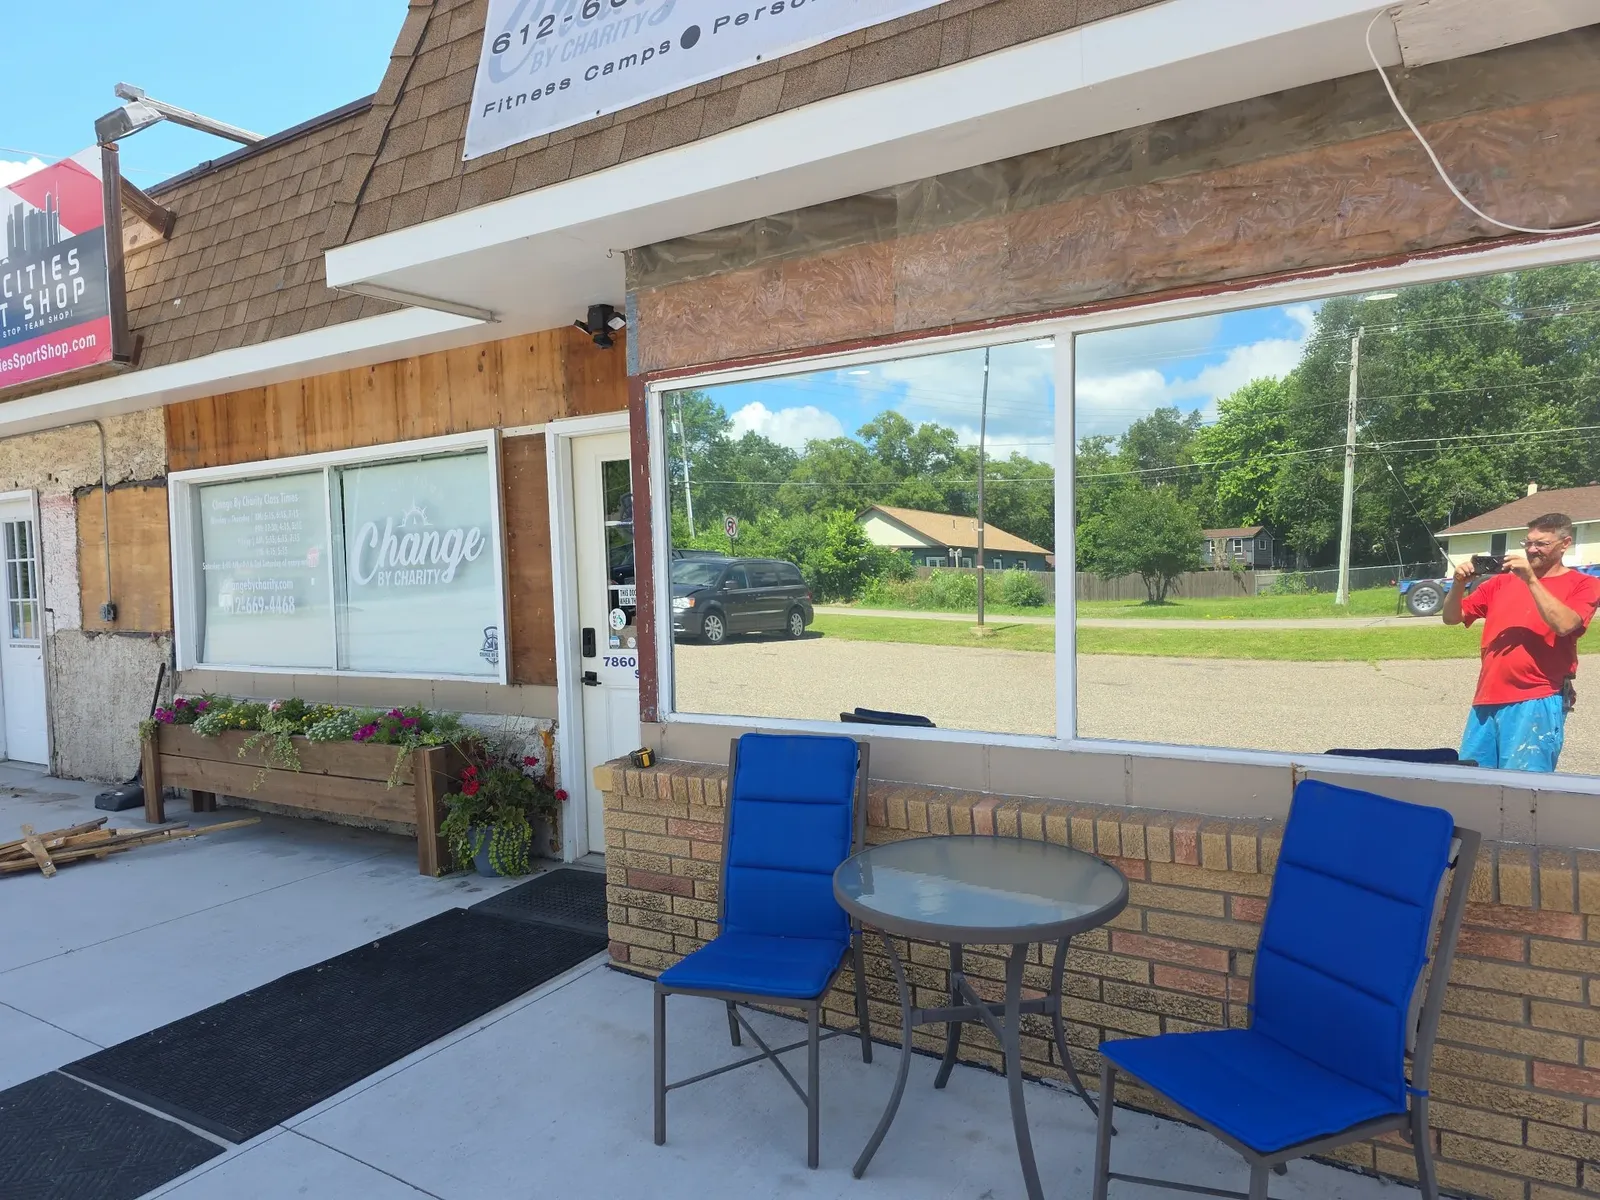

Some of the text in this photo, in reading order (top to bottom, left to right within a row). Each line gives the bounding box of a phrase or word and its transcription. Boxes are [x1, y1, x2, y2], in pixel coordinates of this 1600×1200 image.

[529, 47, 553, 75] BY
[560, 11, 649, 62] CHARITY
[482, 77, 571, 118] Fitness
[584, 40, 671, 82] Camps
[3, 247, 80, 298] CITIES
[23, 276, 85, 320] SHOP
[2, 310, 73, 338] STOP TEAM SHOP!
[351, 517, 486, 586] Change
[222, 576, 294, 593] angebycharity.com
[378, 569, 441, 586] BY CHARITY
[603, 656, 636, 667] 7860
